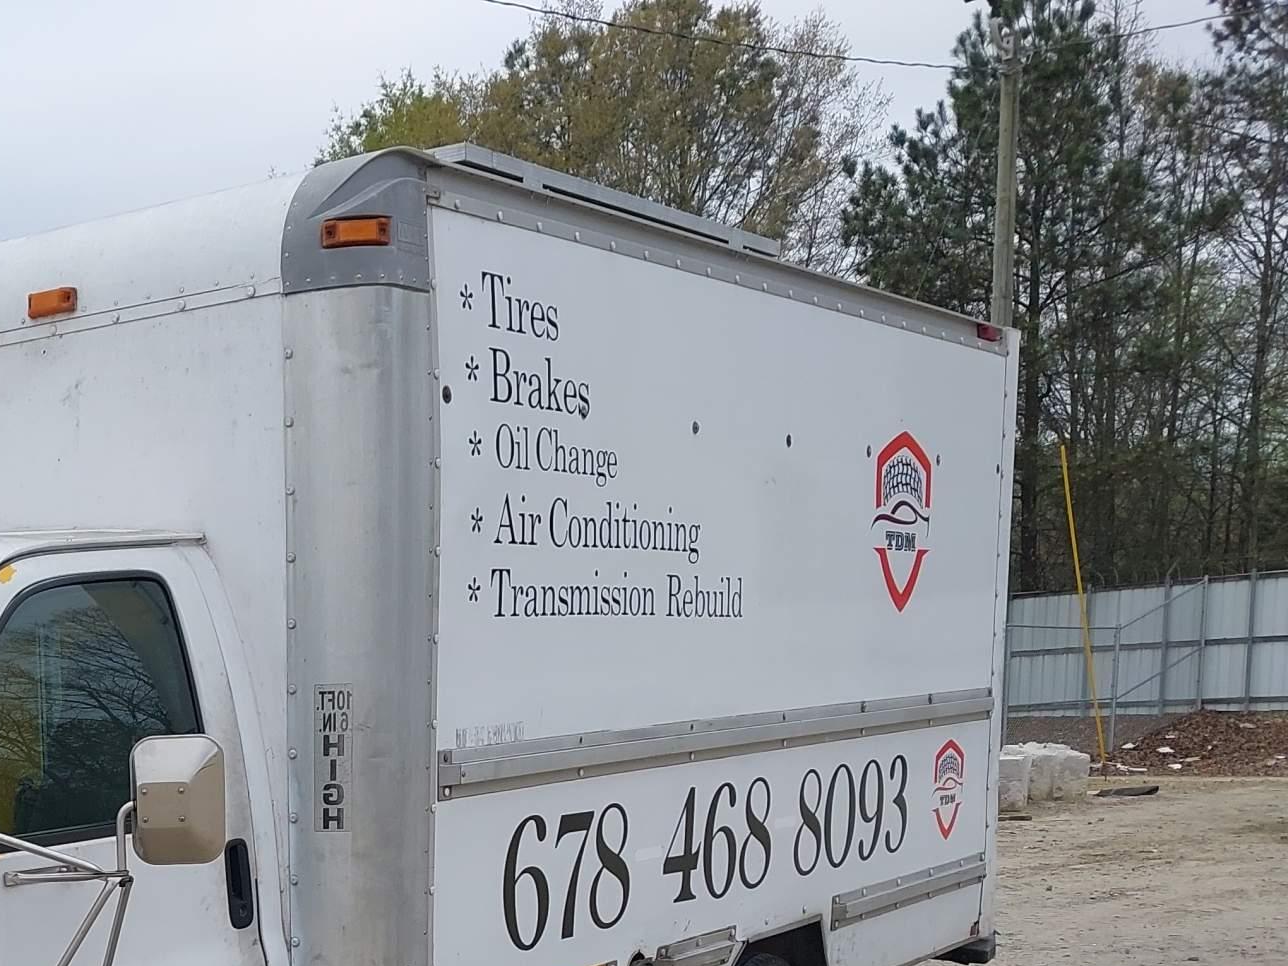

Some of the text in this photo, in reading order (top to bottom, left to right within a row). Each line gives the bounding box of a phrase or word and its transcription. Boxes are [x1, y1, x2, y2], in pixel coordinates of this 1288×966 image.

[481, 271, 560, 341] Tires
[488, 347, 590, 416] Brakes
[495, 424, 618, 487] Oil Change
[494, 493, 701, 564] Air Conditioning
[886, 530, 917, 552] TDM
[490, 568, 743, 619] Transmission Rebuild
[503, 754, 909, 951] 678 468 8093
